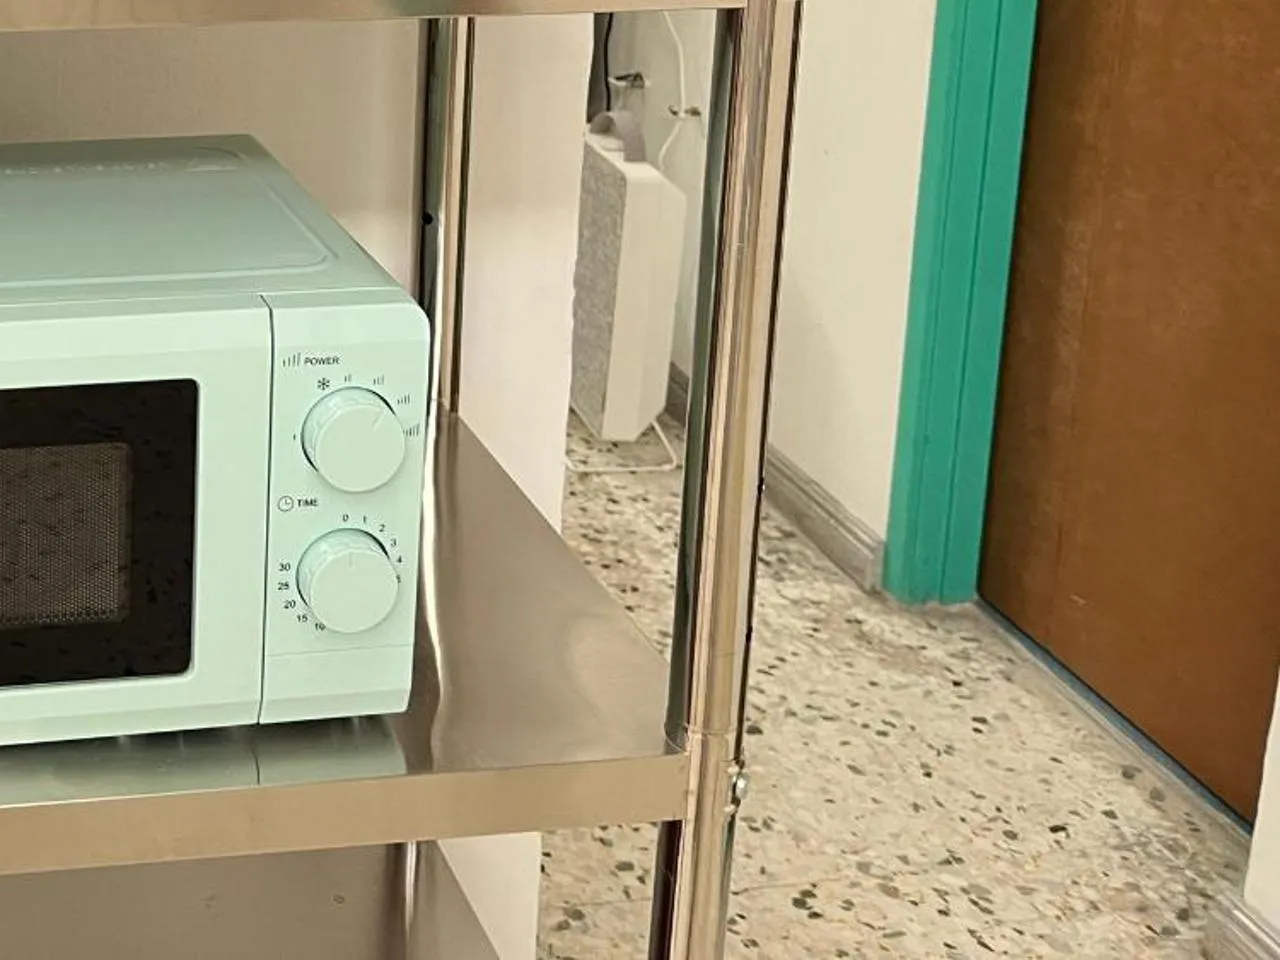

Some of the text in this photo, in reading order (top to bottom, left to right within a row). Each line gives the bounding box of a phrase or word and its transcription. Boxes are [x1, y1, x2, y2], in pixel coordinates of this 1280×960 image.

[304, 356, 341, 366] POWER
[297, 498, 319, 508] TIME
[278, 562, 291, 572] 30
[277, 581, 290, 591] 25
[283, 599, 296, 609] 20
[297, 613, 308, 623] 15
